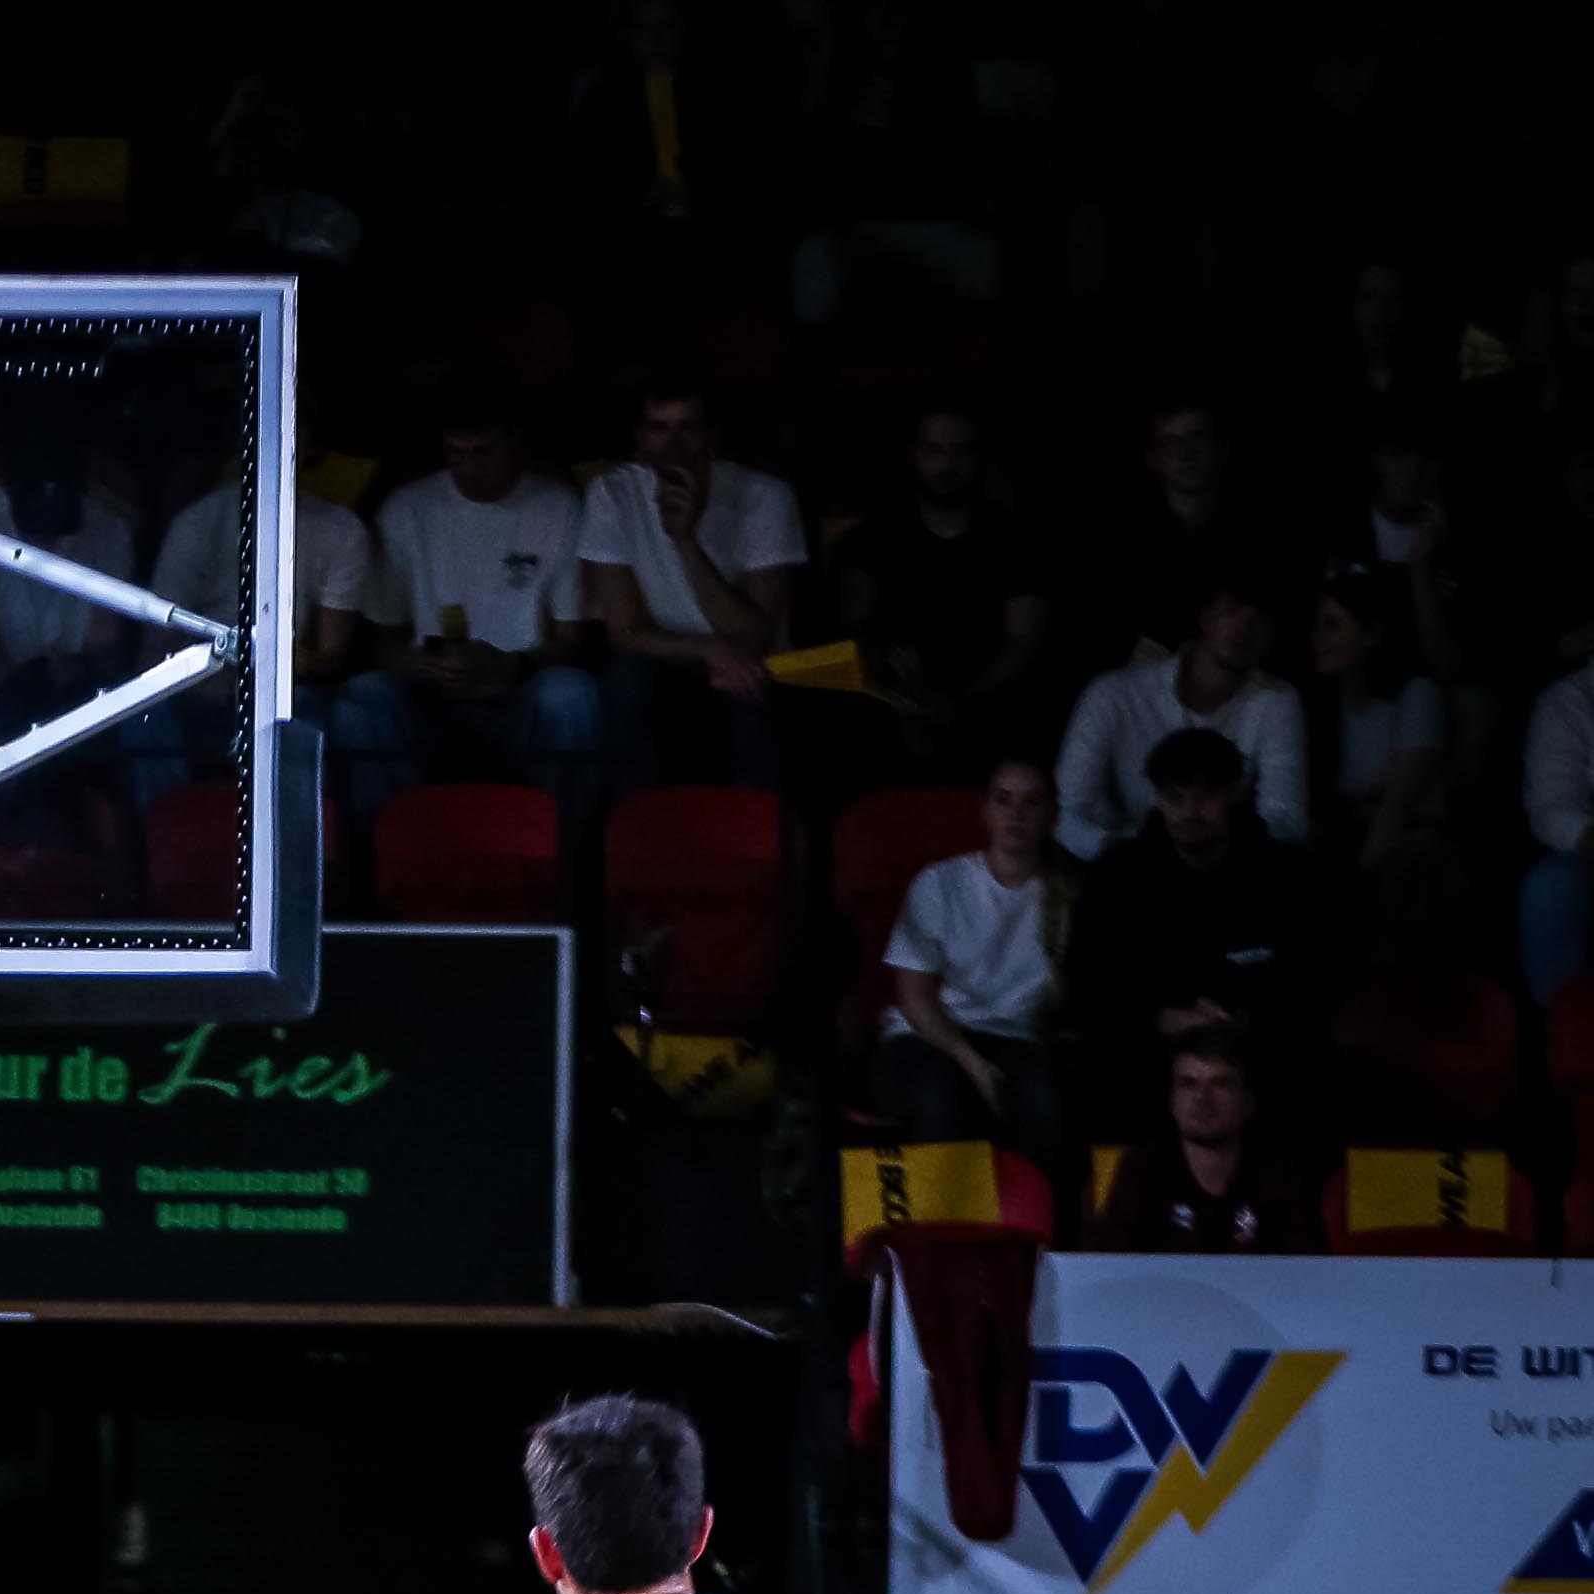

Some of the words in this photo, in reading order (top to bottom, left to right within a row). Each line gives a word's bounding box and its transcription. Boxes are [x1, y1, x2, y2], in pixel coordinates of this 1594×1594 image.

[59, 1045, 129, 1102] de
[138, 1022, 394, 1103] Lies
[1423, 1344, 1498, 1377] DE
